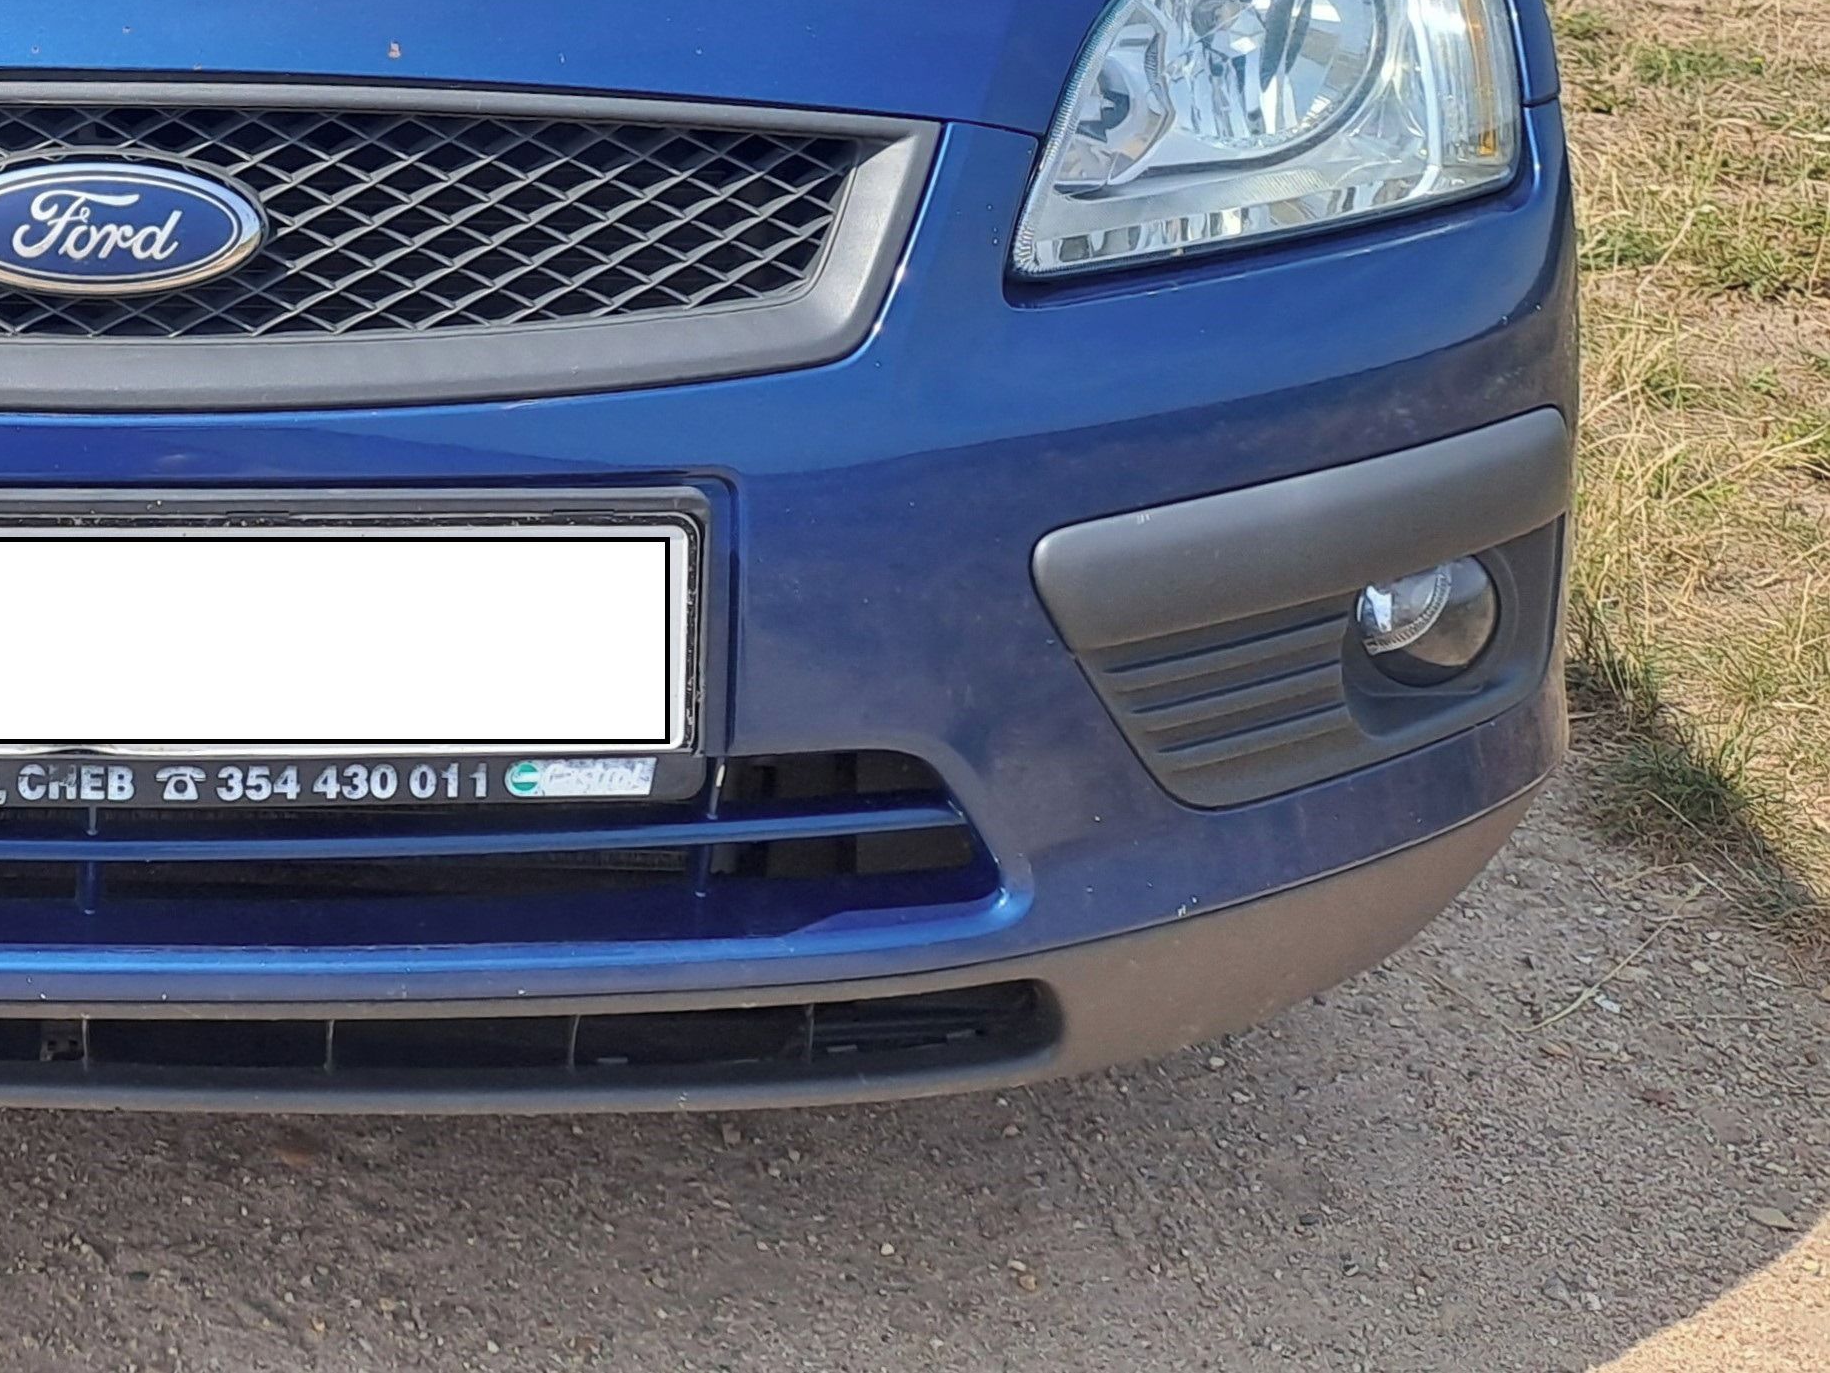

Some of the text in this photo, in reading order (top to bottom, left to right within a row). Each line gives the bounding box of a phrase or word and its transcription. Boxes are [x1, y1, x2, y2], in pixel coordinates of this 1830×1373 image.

[12, 189, 182, 260] Ford
[17, 764, 134, 801] CHEB
[216, 765, 301, 801] 354
[313, 764, 398, 800] 430
[409, 763, 487, 799] 011
